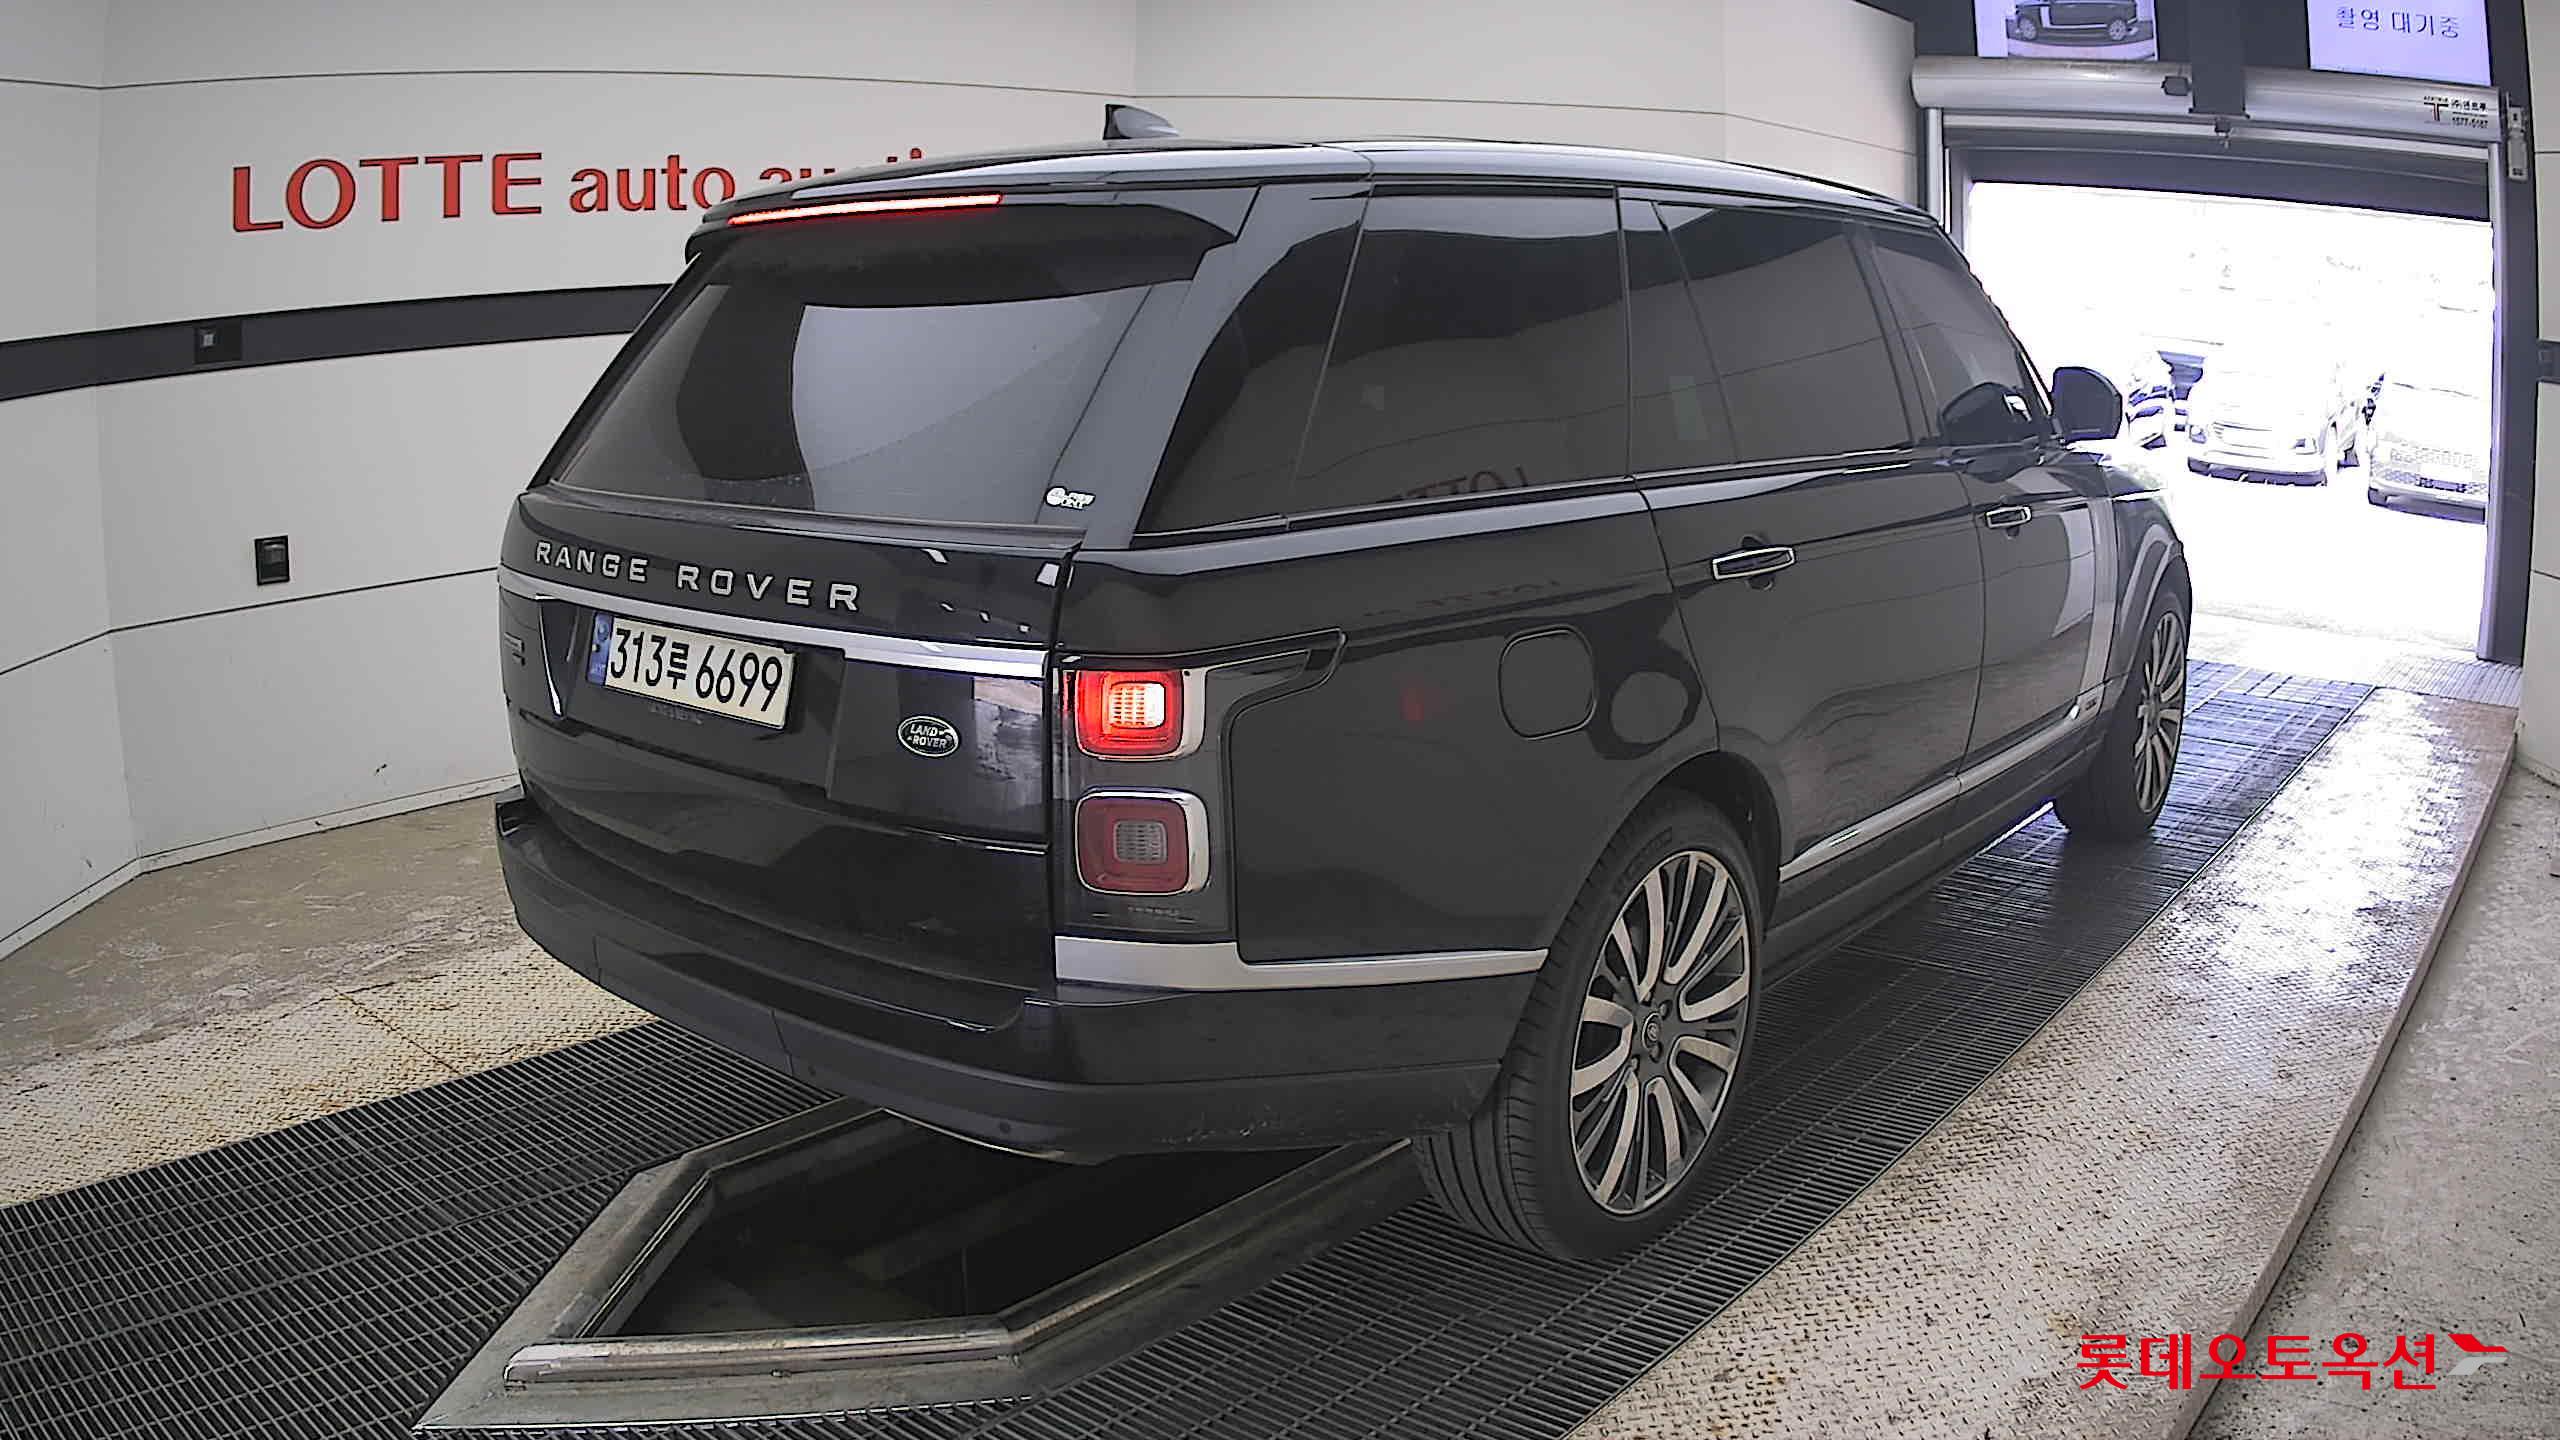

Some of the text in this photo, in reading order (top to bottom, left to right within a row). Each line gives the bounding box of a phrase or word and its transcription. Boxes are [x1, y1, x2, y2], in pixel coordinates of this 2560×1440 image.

[2391, 12, 2458, 38] 대기중
[233, 153, 542, 232] LOTTE
[569, 154, 736, 213] auto
[536, 541, 858, 611] RANGE ROVER
